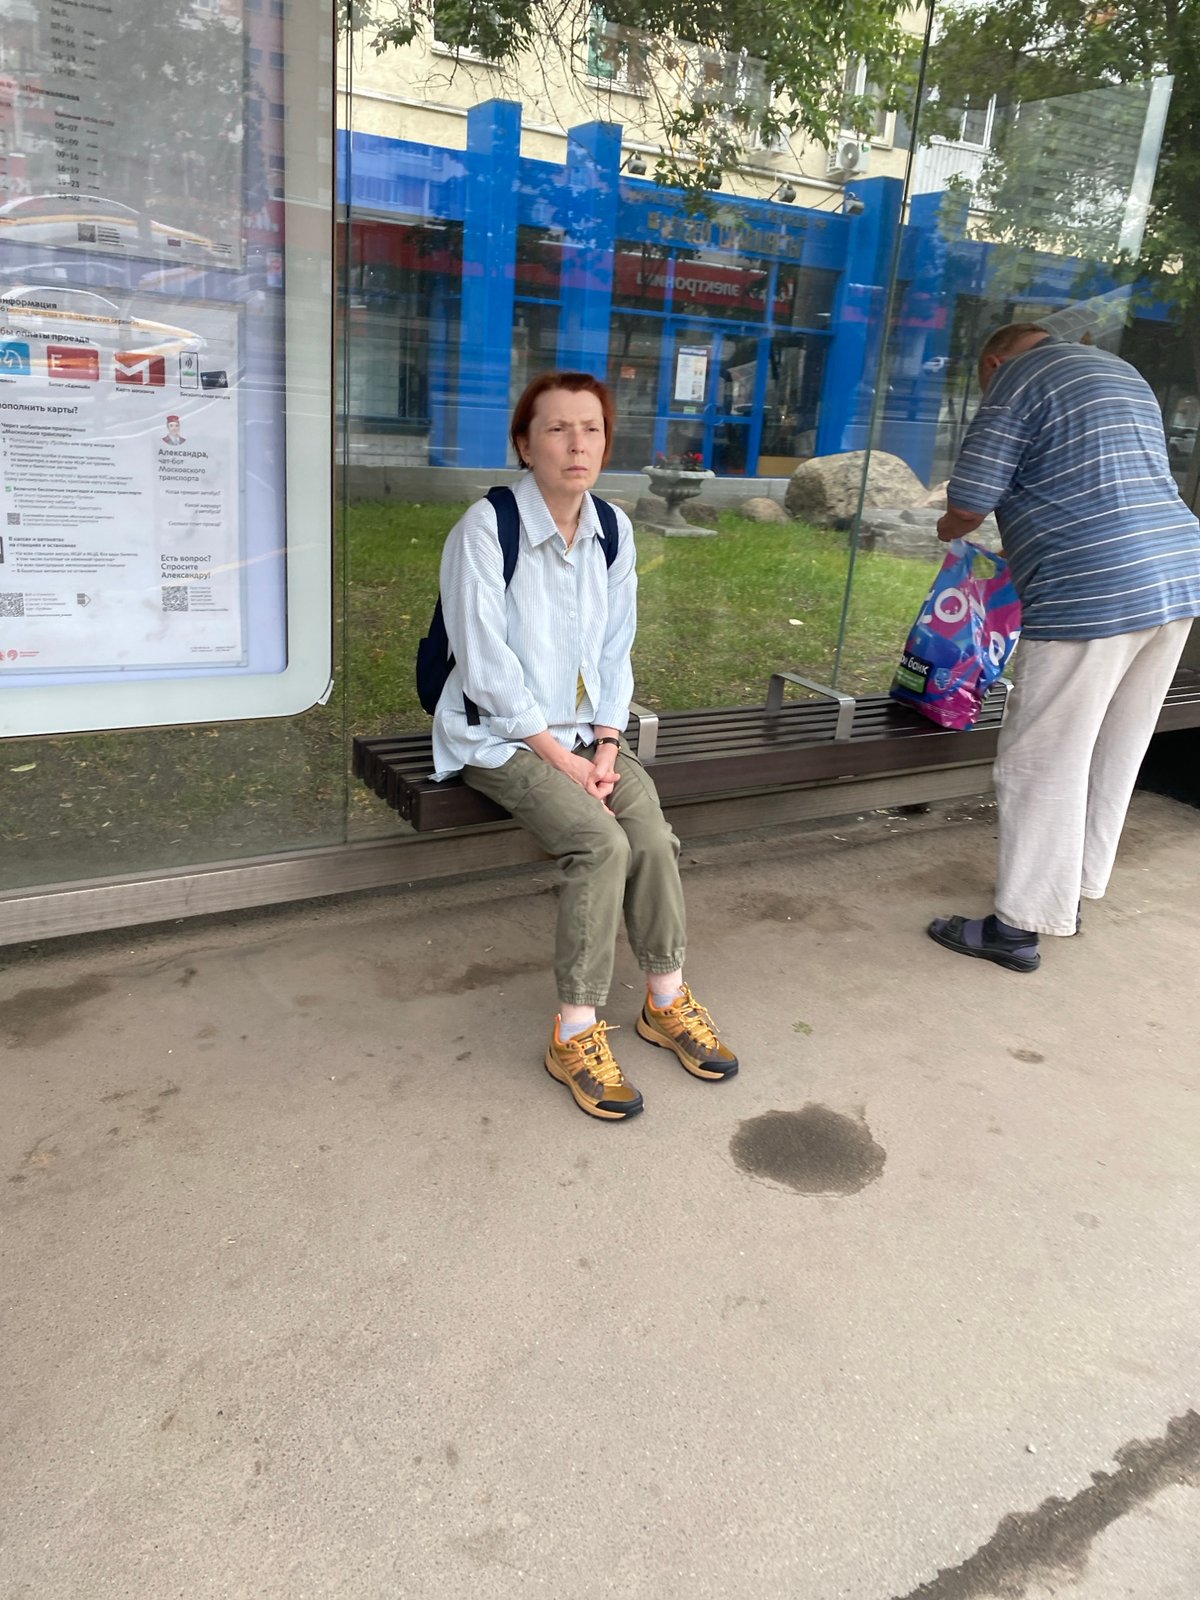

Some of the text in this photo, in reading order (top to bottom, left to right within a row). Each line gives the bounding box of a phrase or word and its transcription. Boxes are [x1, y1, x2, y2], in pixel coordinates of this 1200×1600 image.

[47, 406, 78, 414] карты?
[158, 449, 209, 459] Александра,
[159, 466, 206, 474] Московского
[161, 554, 211, 563] Есть вопрос?
[160, 562, 198, 571] Спросите
[161, 571, 211, 580] Александру!
[907, 656, 930, 675] банк
